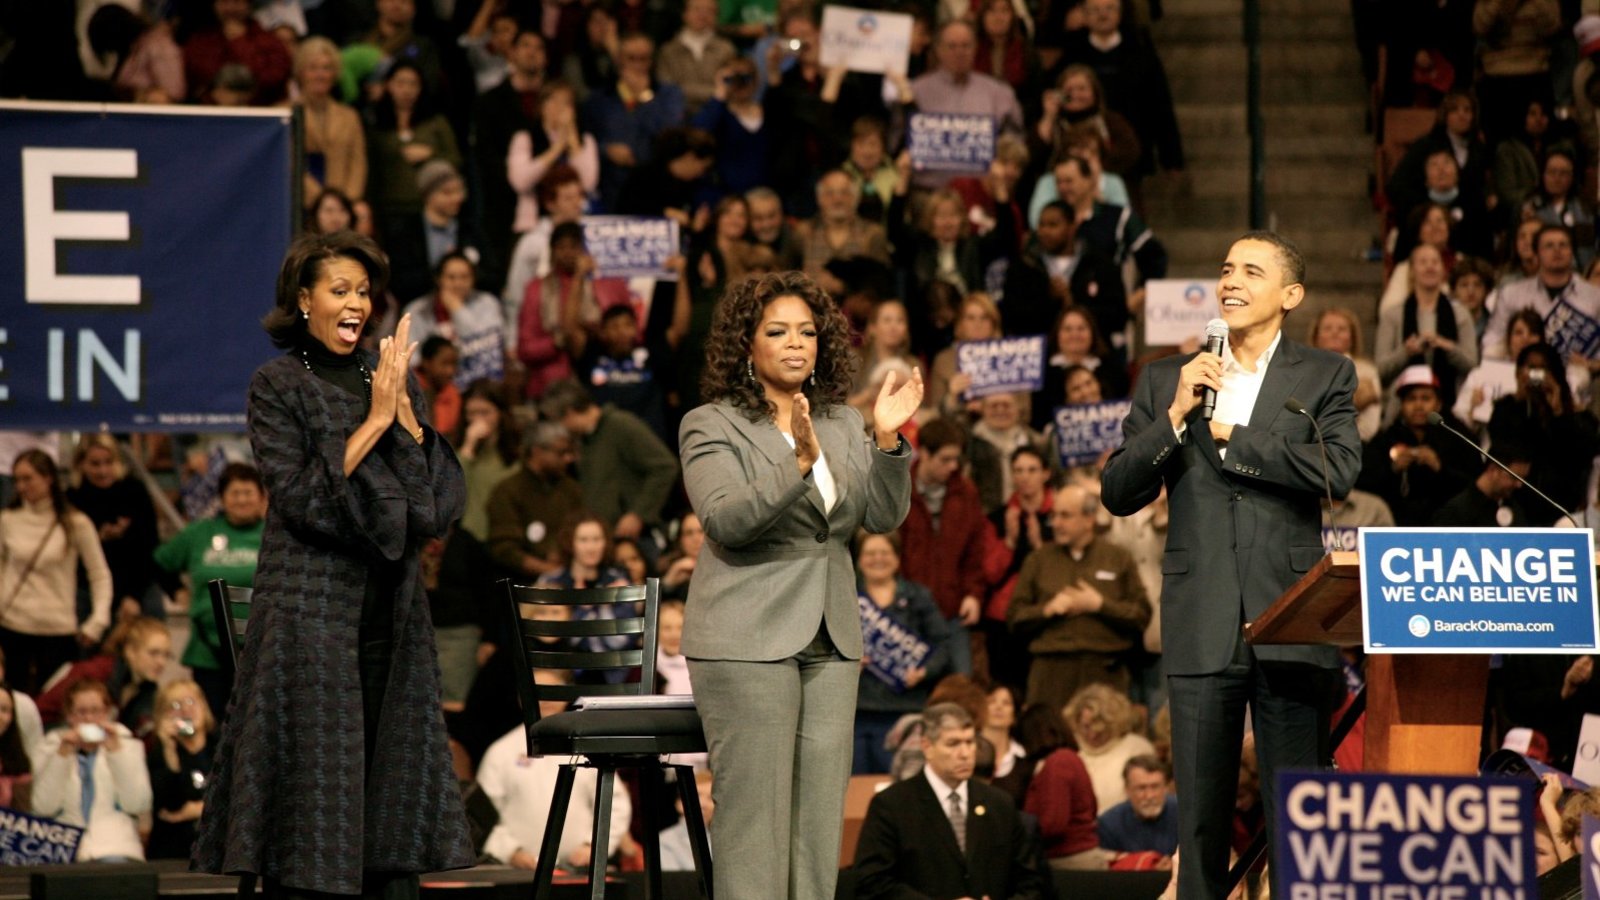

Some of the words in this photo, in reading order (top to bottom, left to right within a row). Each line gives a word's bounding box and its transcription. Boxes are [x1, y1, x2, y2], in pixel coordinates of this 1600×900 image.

[48, 328, 140, 401] IN
[959, 337, 1042, 363] CHANGE
[1056, 402, 1132, 427] CHANG
[1380, 547, 1577, 584] CHANGE
[1381, 586, 1415, 602] WE
[1420, 586, 1464, 602] CAN
[1470, 586, 1552, 602] BELIEVE
[1557, 587, 1578, 602] IN
[1434, 620, 1554, 633] BarackObama.com
[1287, 780, 1523, 834] CHANGE
[0, 811, 80, 848] HANGE
[1288, 831, 1384, 882] WE
[1399, 833, 1525, 885] CAN
